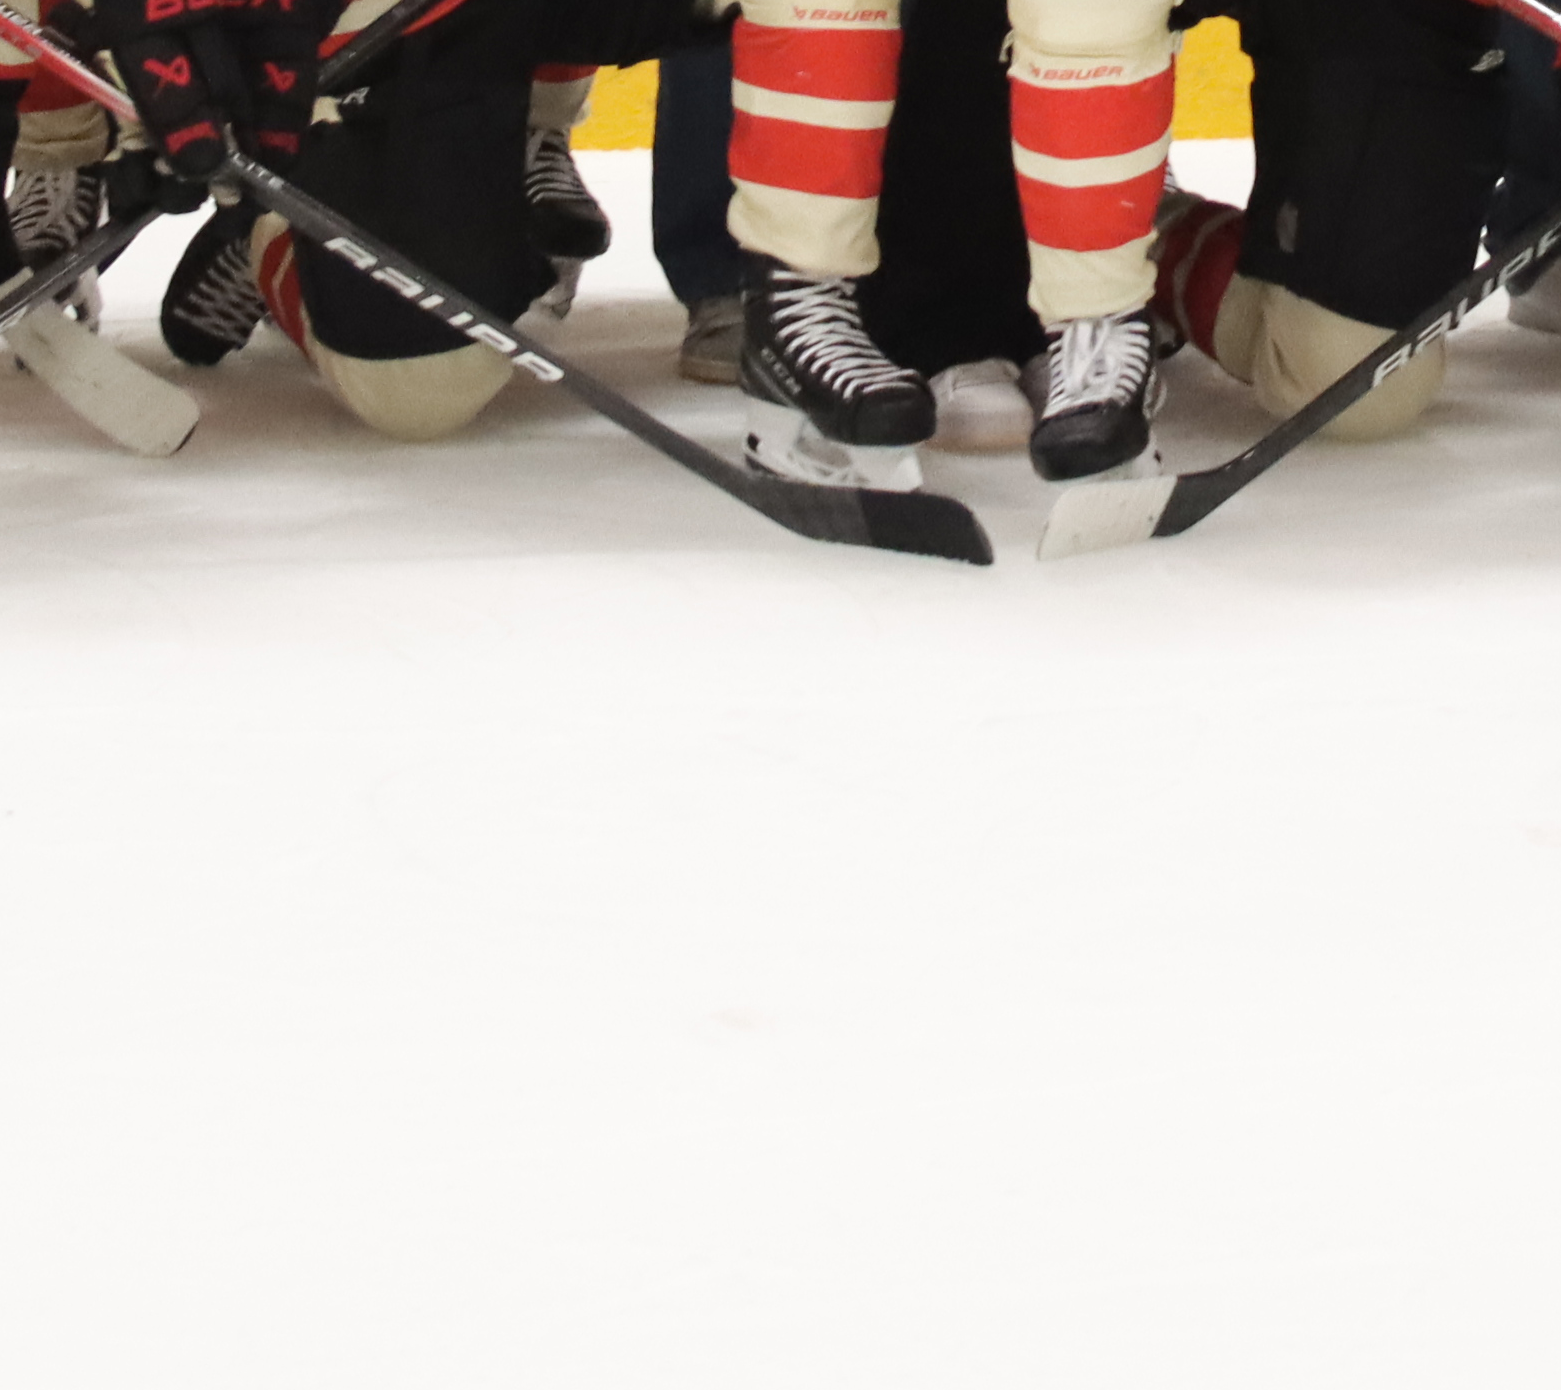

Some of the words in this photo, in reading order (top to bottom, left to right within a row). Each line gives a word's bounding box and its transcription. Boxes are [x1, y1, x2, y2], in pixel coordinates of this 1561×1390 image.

[809, 6, 889, 23] BAUER
[1042, 64, 1126, 82] BAUER
[323, 235, 567, 384] BAUER
